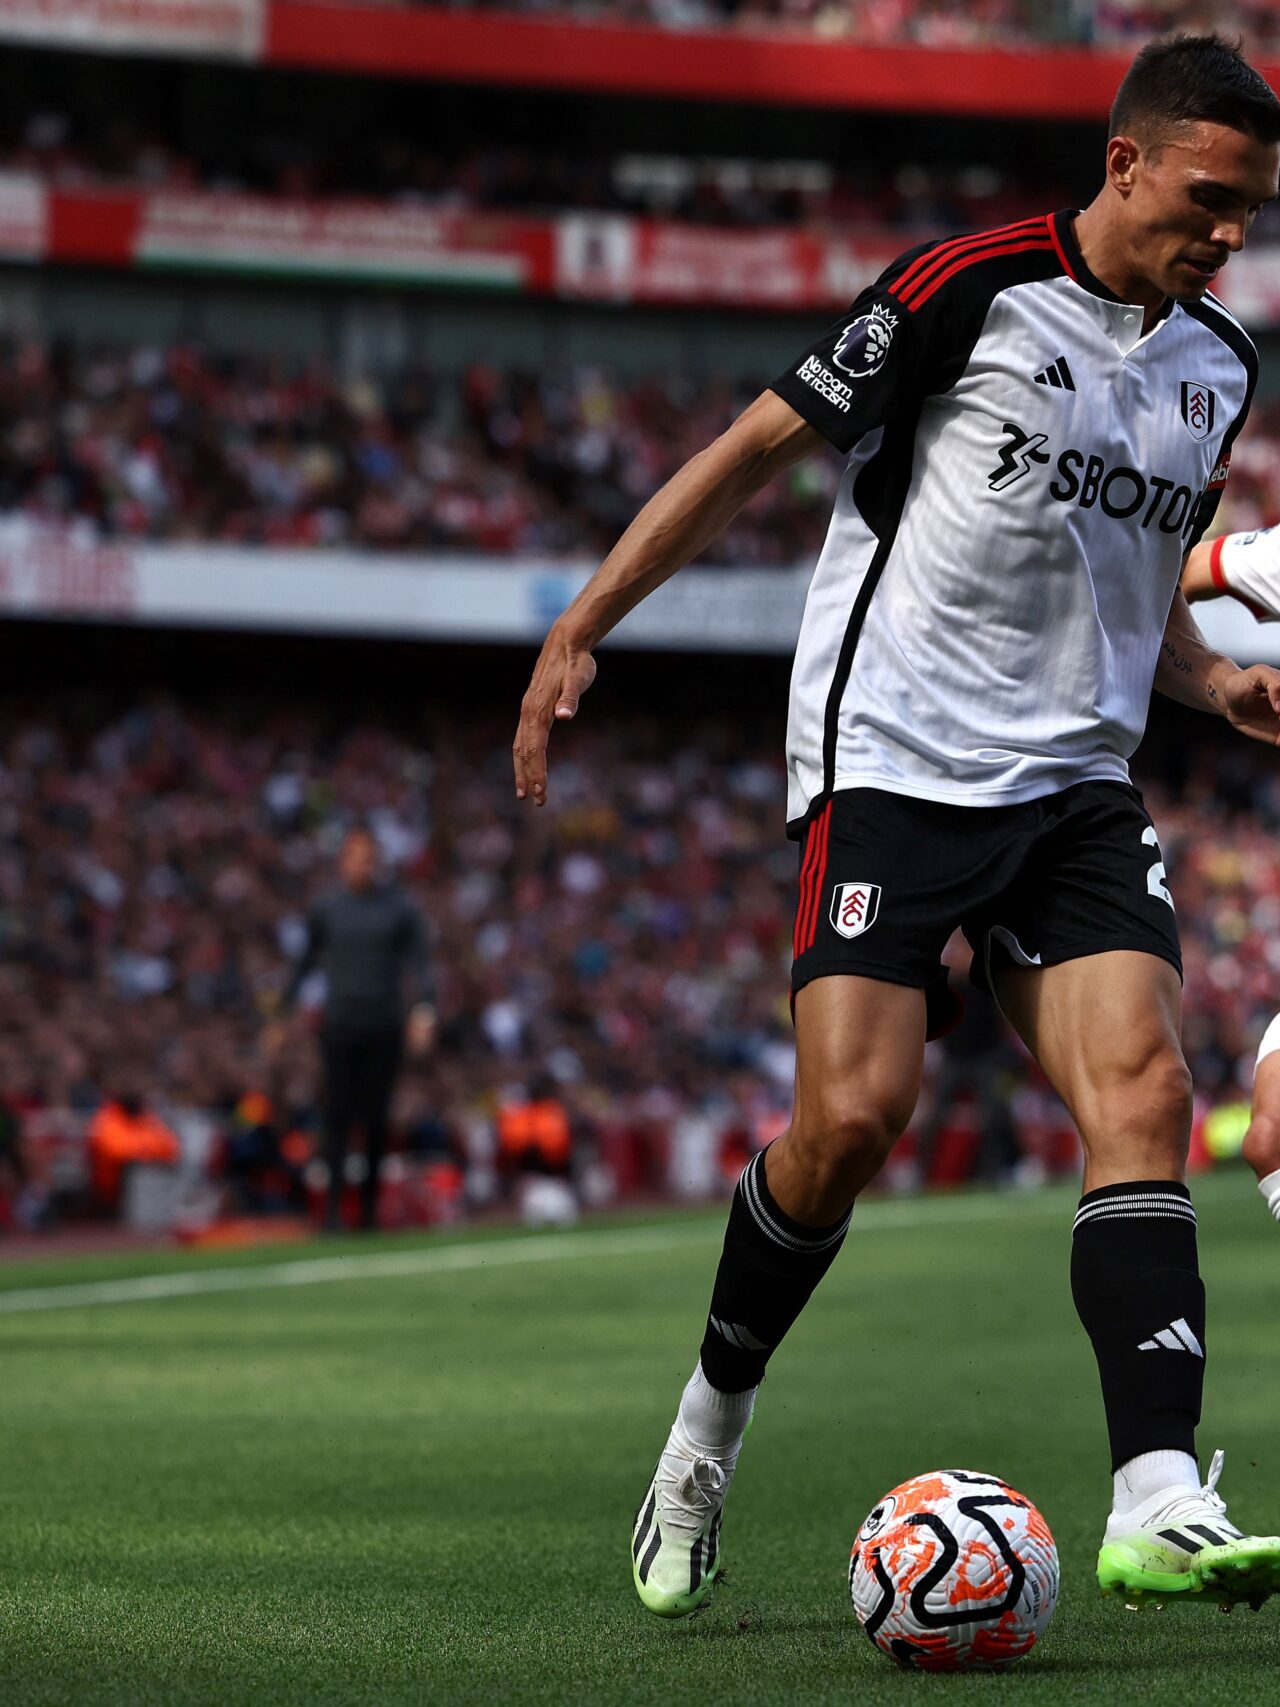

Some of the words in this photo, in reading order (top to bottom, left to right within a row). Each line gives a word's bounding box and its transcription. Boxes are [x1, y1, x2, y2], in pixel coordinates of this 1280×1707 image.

[802, 354, 822, 374] No
[818, 368, 853, 400] room
[810, 377, 851, 413] racism
[1189, 390, 1207, 429] FFC
[842, 889, 867, 927] FFC
